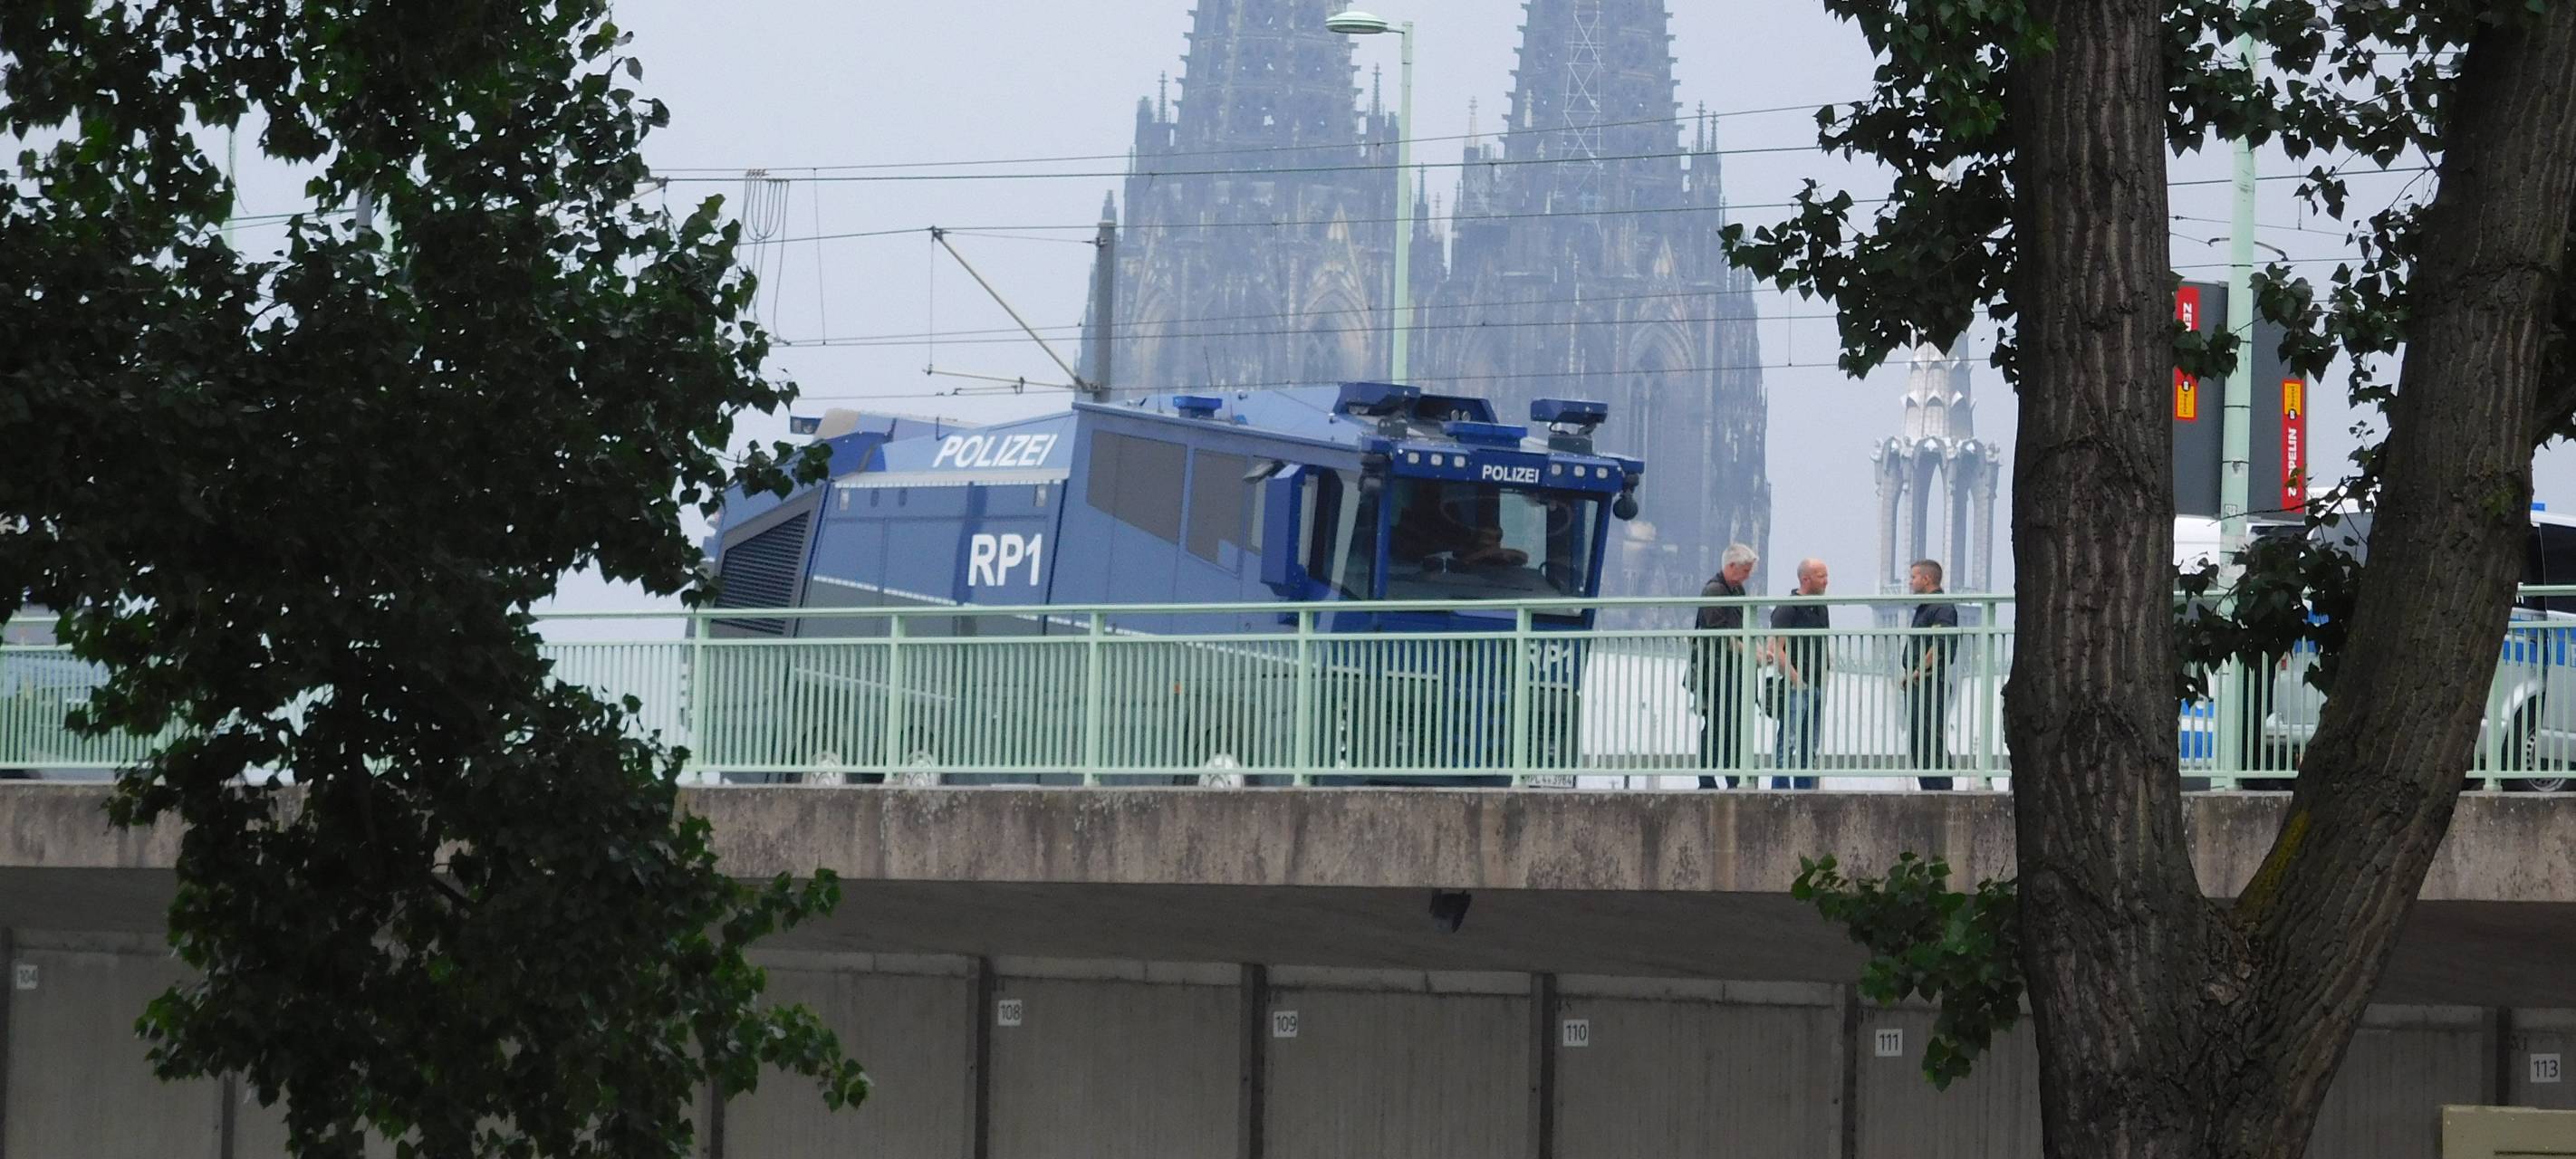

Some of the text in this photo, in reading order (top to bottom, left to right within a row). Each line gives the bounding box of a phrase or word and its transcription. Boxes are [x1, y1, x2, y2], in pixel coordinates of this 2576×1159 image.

[932, 433, 1058, 468] POLIZEI
[2288, 427, 2298, 498] ZPELIN
[1482, 465, 1540, 484] POLIZEI
[967, 532, 1043, 587] RP1
[1000, 1004, 1021, 1020] 108
[1275, 1015, 1297, 1032] 109
[1566, 1024, 1587, 1041] 110
[1879, 1034, 1898, 1051] 111
[2533, 1059, 2559, 1078] 113
